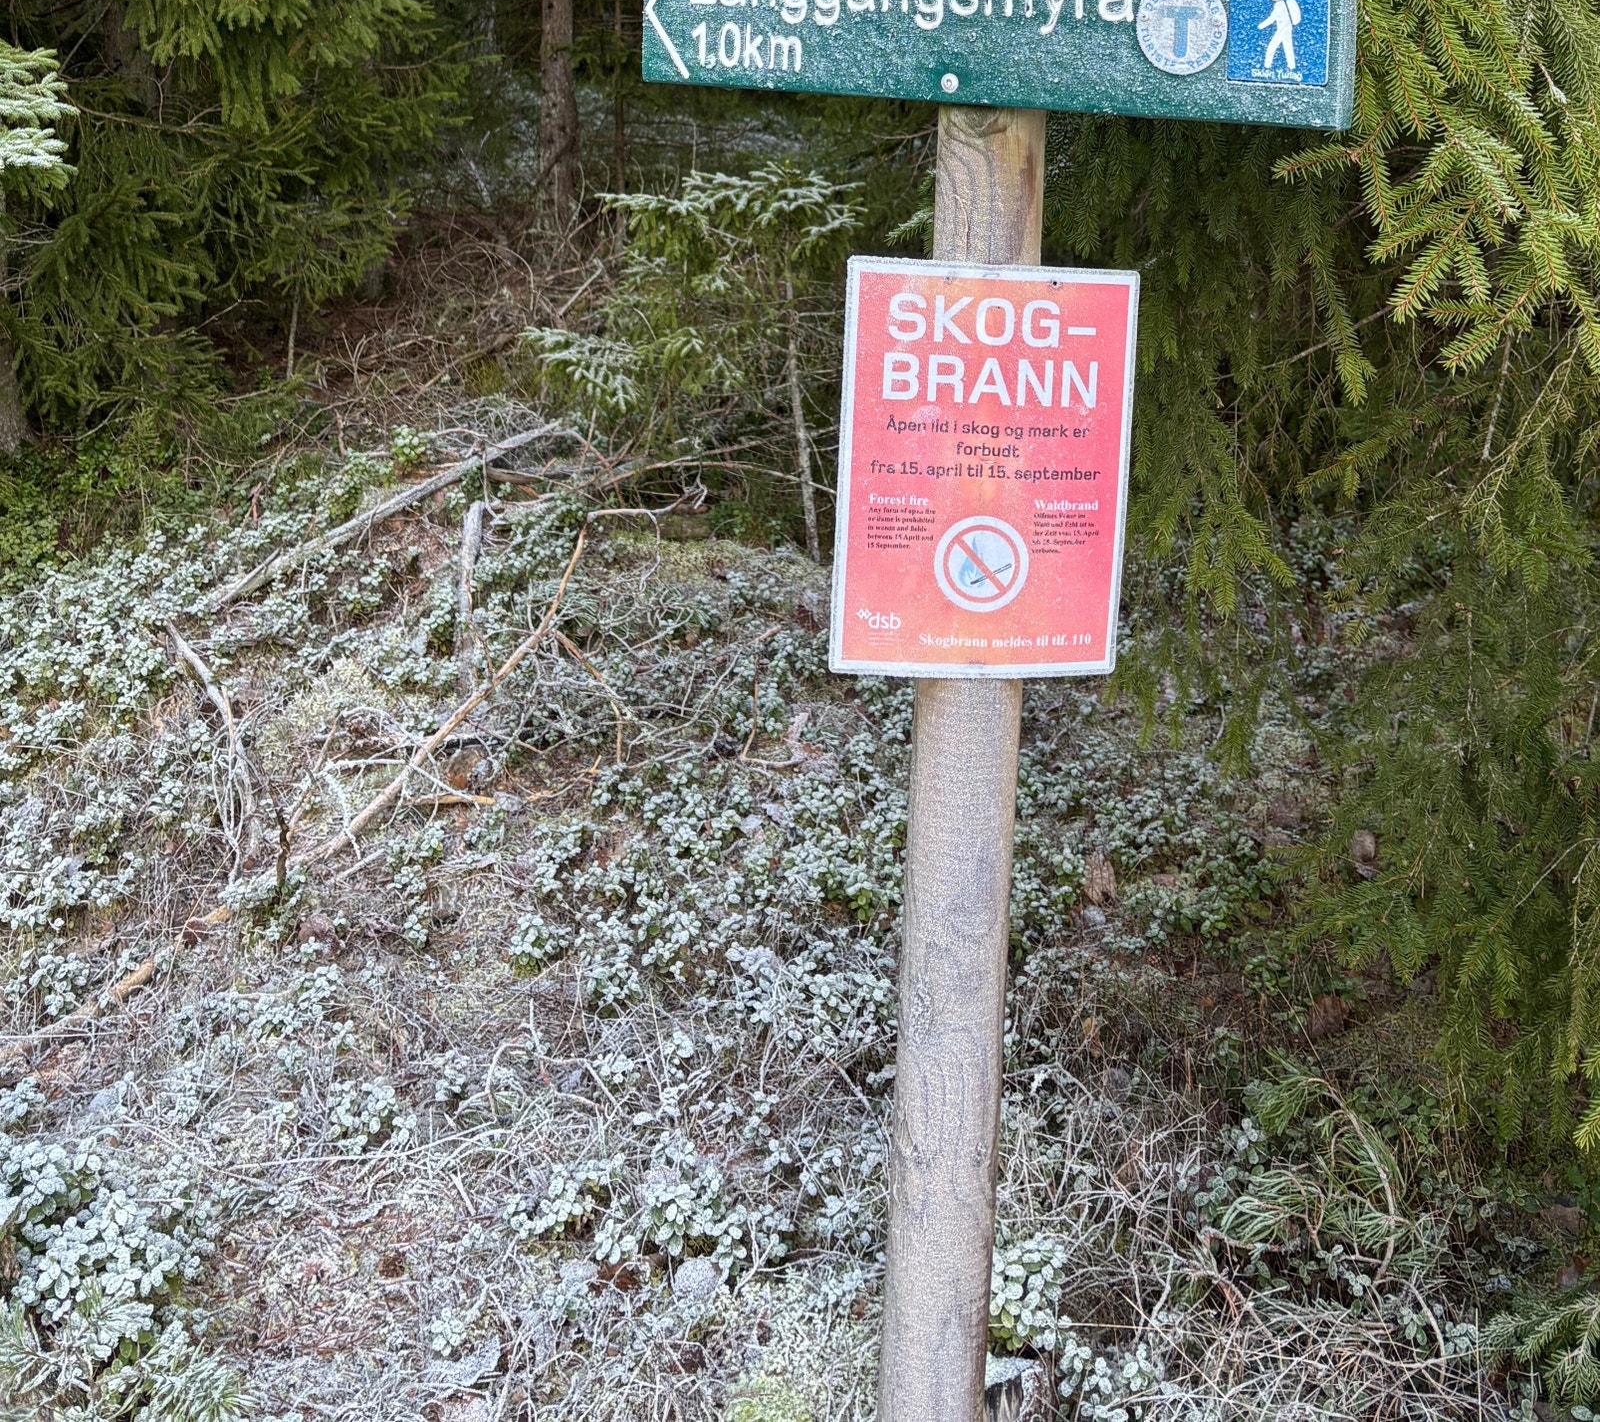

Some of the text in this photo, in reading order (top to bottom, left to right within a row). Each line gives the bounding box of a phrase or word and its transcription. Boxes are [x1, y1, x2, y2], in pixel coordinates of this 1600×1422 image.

[1158, 5, 1205, 58] T
[692, 21, 802, 72] 1.0km
[888, 292, 1097, 348] SKOG-
[882, 352, 1099, 408] BRANN
[886, 415, 926, 434] Åpen
[962, 421, 1000, 438] skog
[1005, 426, 1023, 439] og
[1028, 424, 1068, 437] mark
[1073, 427, 1090, 438] er
[956, 442, 1019, 458] forbudt
[870, 460, 1101, 483] fra 15. april til 15. september
[868, 493, 929, 506] Forest fire
[1034, 499, 1099, 511] Waldbrand
[868, 612, 901, 629] dsb
[918, 633, 1091, 649] Skogbrann meldes til tlf. 110
